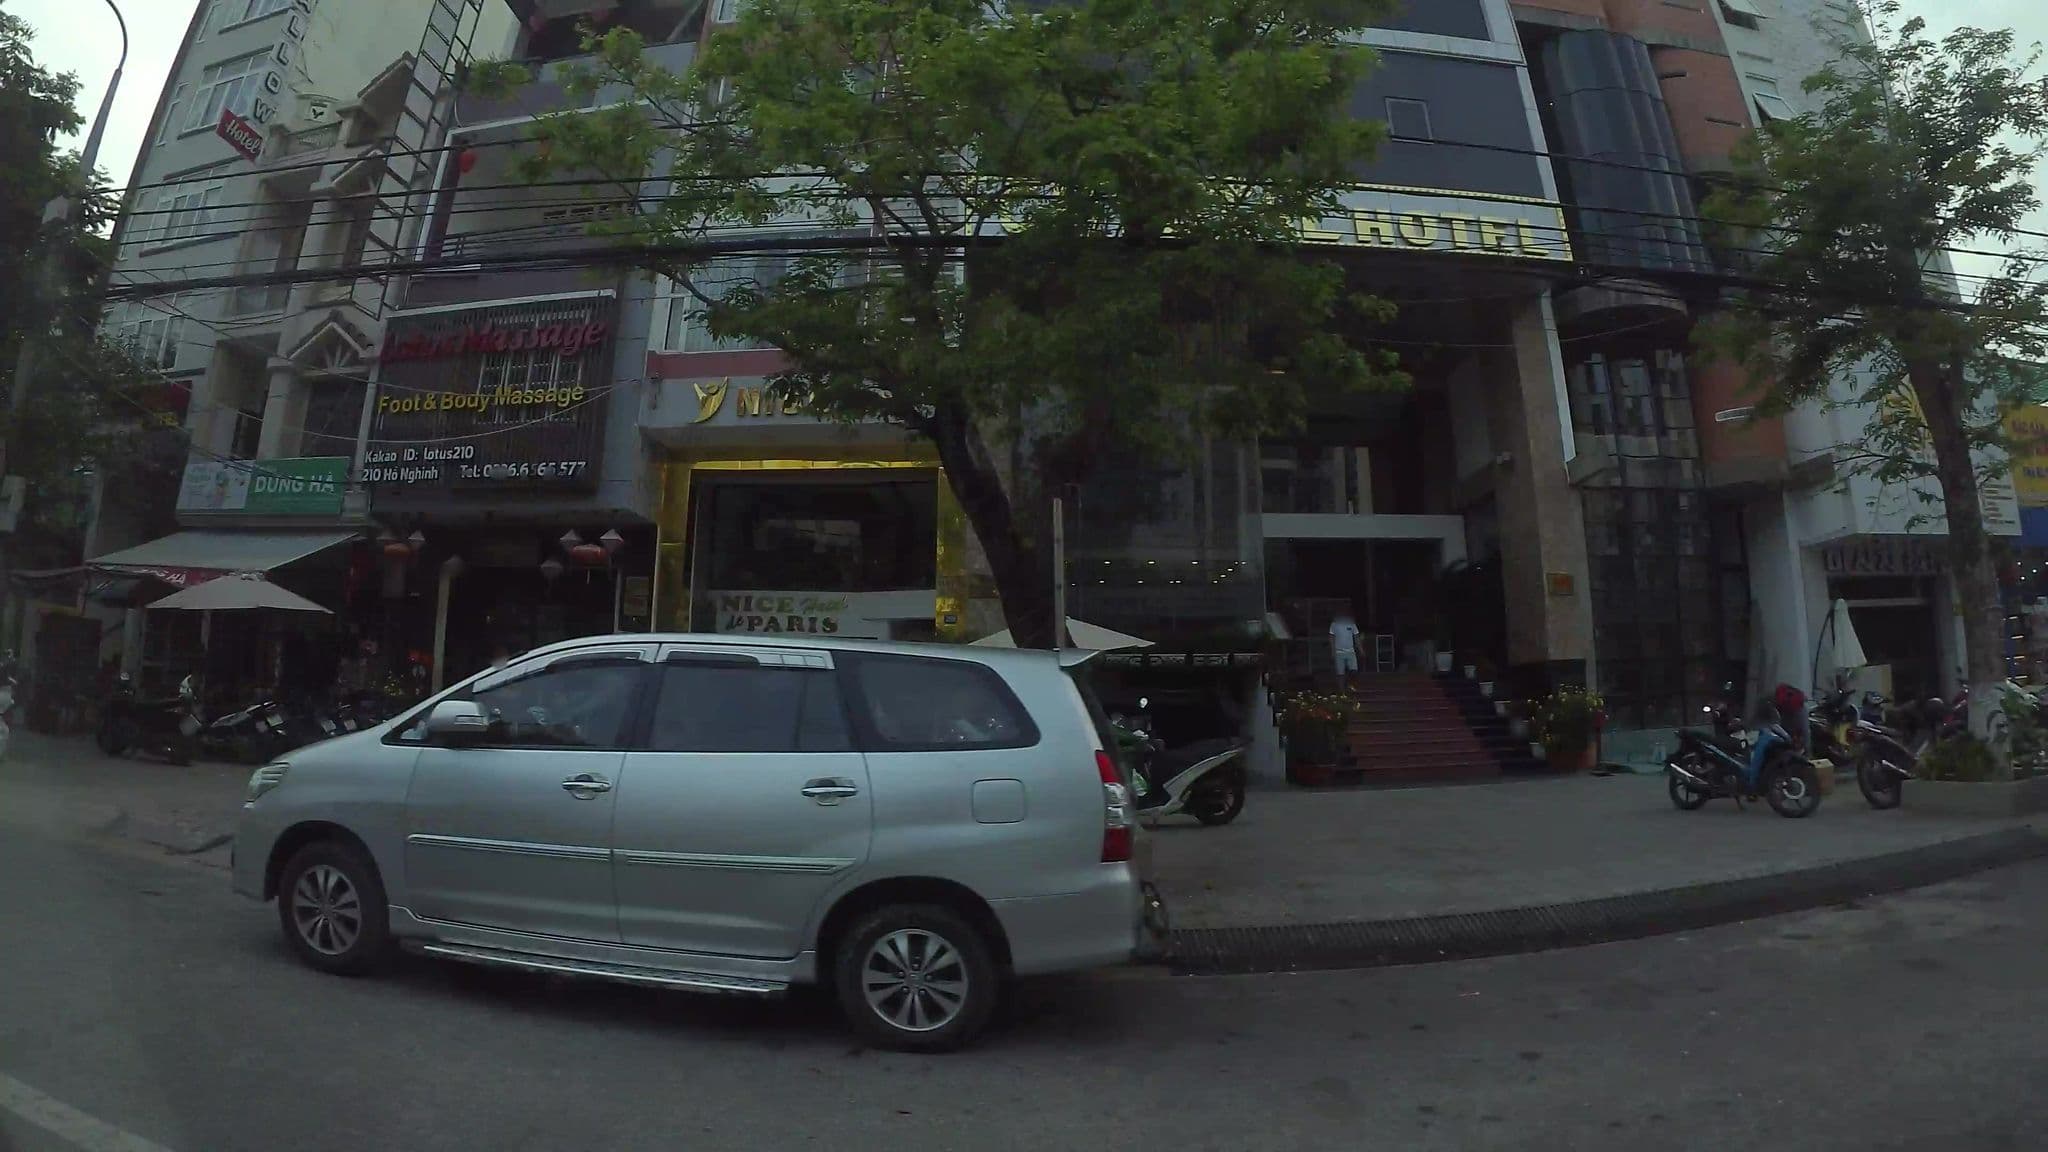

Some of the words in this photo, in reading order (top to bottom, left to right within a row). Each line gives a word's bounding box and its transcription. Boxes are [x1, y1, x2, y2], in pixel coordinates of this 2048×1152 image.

[225, 119, 261, 154] Hotel
[1355, 208, 1548, 257] HOTEL
[378, 392, 421, 414] Foot
[422, 390, 438, 409] &
[495, 385, 585, 408] Massage
[365, 449, 398, 463] Kakao
[403, 448, 418, 461] ID:
[362, 468, 381, 481] 210
[721, 596, 794, 612] NICE
[748, 615, 839, 633] PARIS
